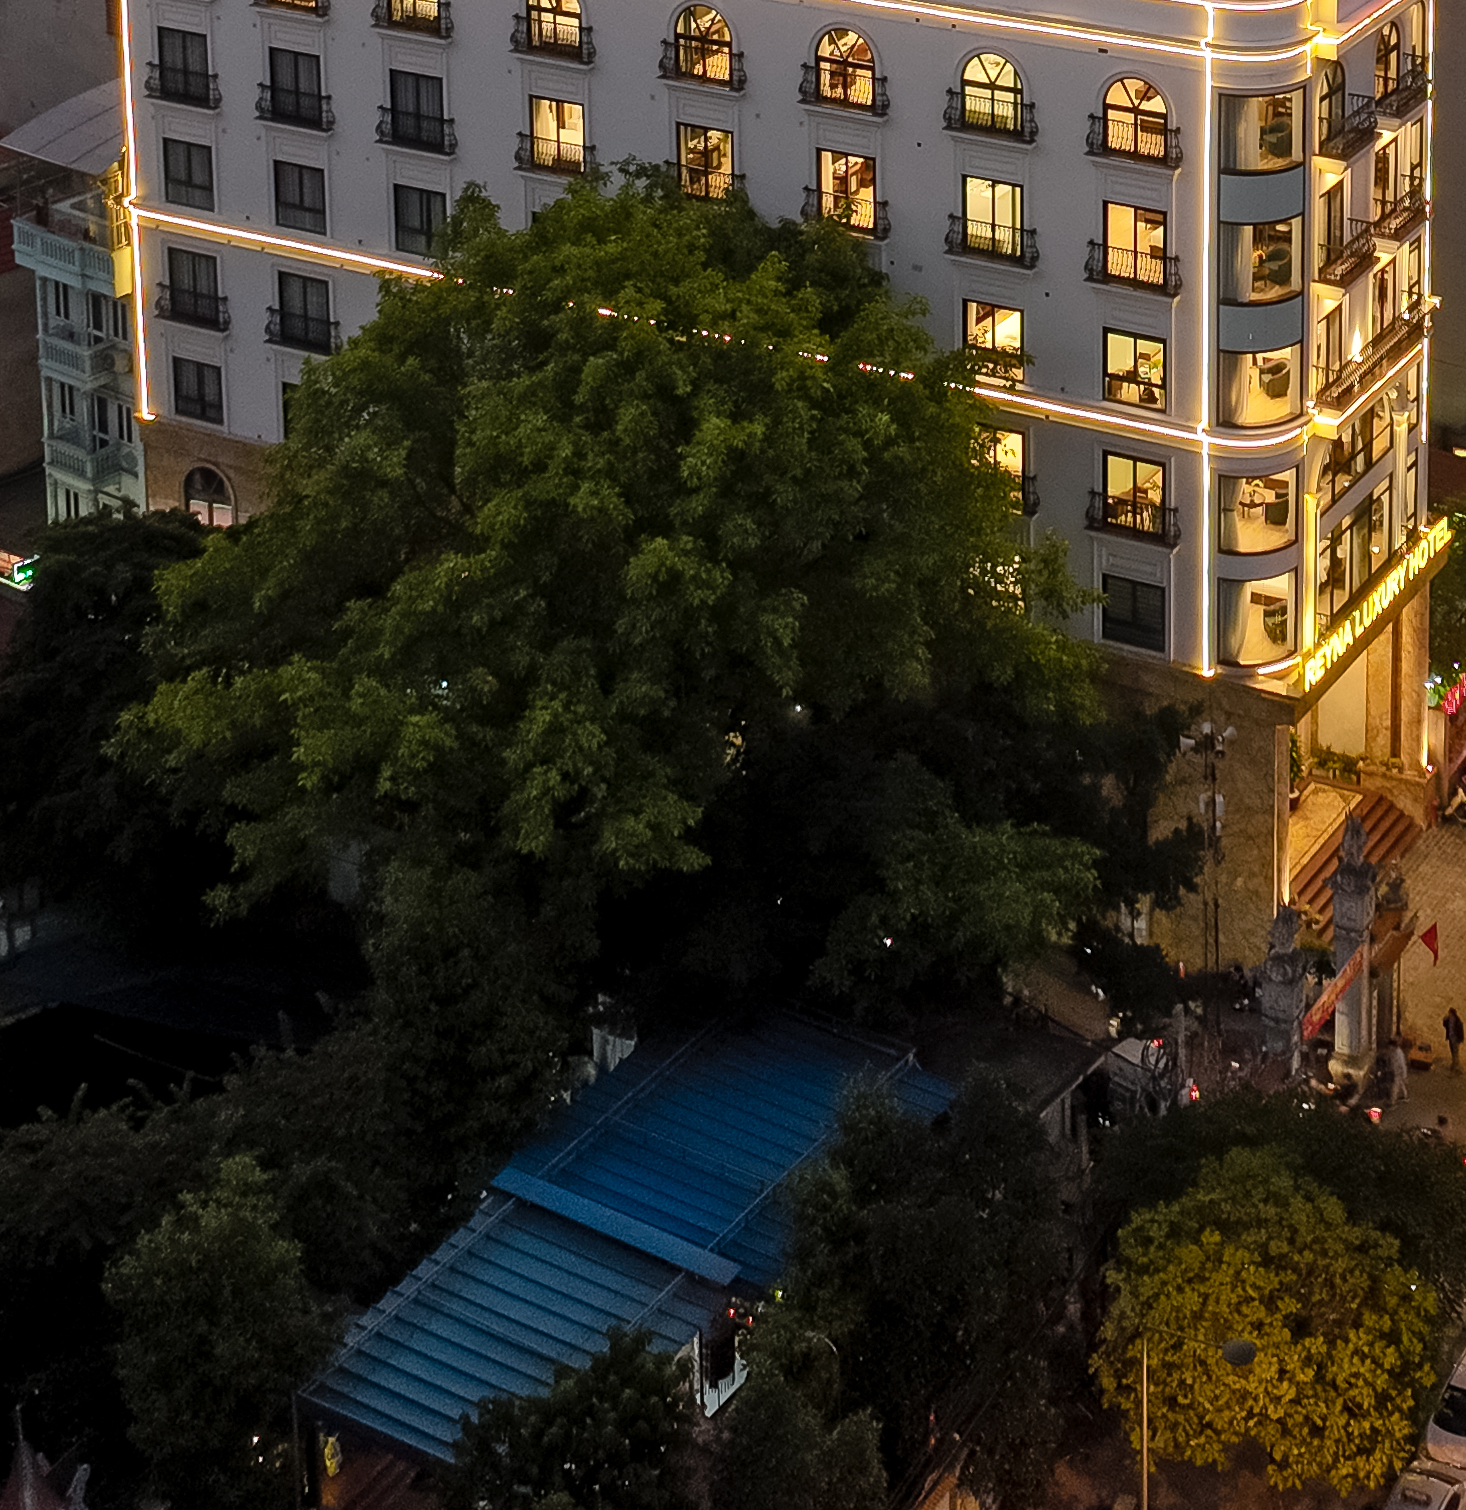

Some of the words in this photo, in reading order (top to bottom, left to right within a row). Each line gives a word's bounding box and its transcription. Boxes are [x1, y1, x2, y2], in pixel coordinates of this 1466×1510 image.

[1304, 619, 1354, 693] REYNA
[1353, 558, 1408, 638] LUXURY
[1406, 515, 1452, 581] HOTEL
